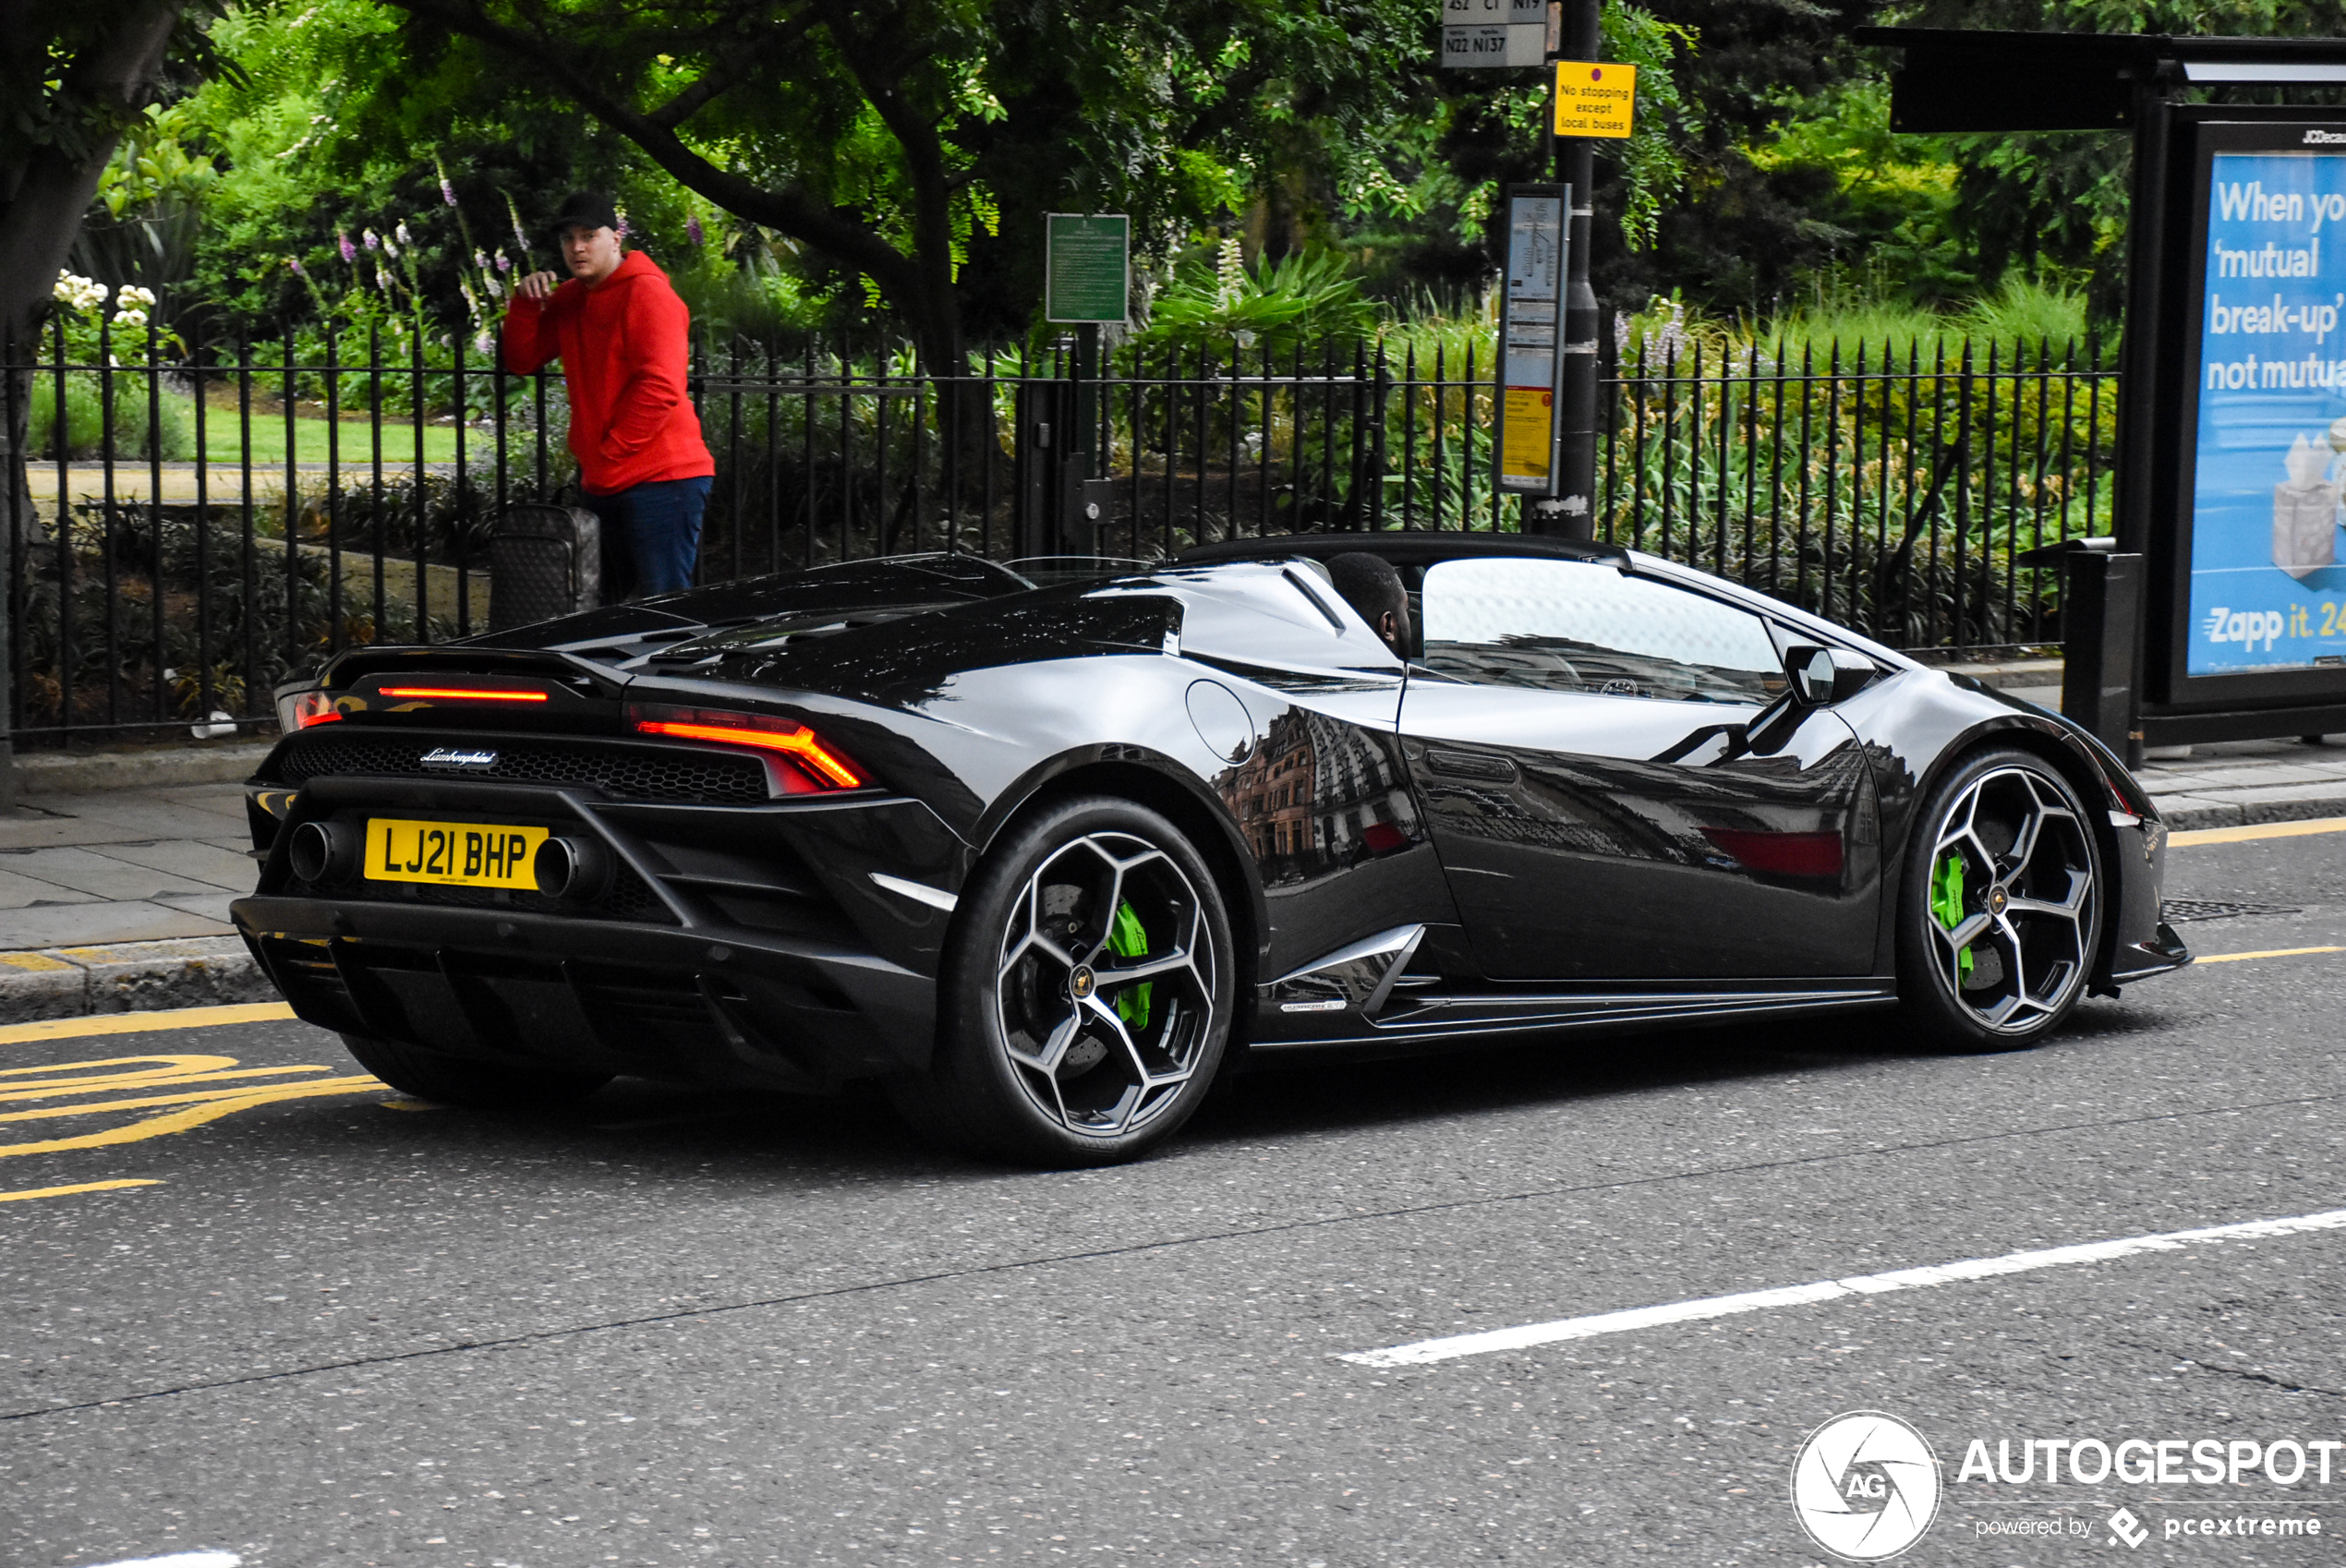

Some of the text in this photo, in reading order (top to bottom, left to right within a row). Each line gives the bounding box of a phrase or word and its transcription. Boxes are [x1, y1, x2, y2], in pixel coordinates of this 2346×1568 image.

[1445, 37, 1506, 53] N22 N137
[1561, 84, 1629, 101] No stopping
[1576, 103, 1613, 115] except
[1561, 116, 1625, 130] local buses
[2219, 180, 2304, 222] When
[2207, 354, 2259, 390] not
[2208, 607, 2284, 653] Zapp
[2290, 602, 2315, 638] it.
[420, 748, 495, 766] Lamborghini
[384, 827, 526, 879] LJ21 BHP
